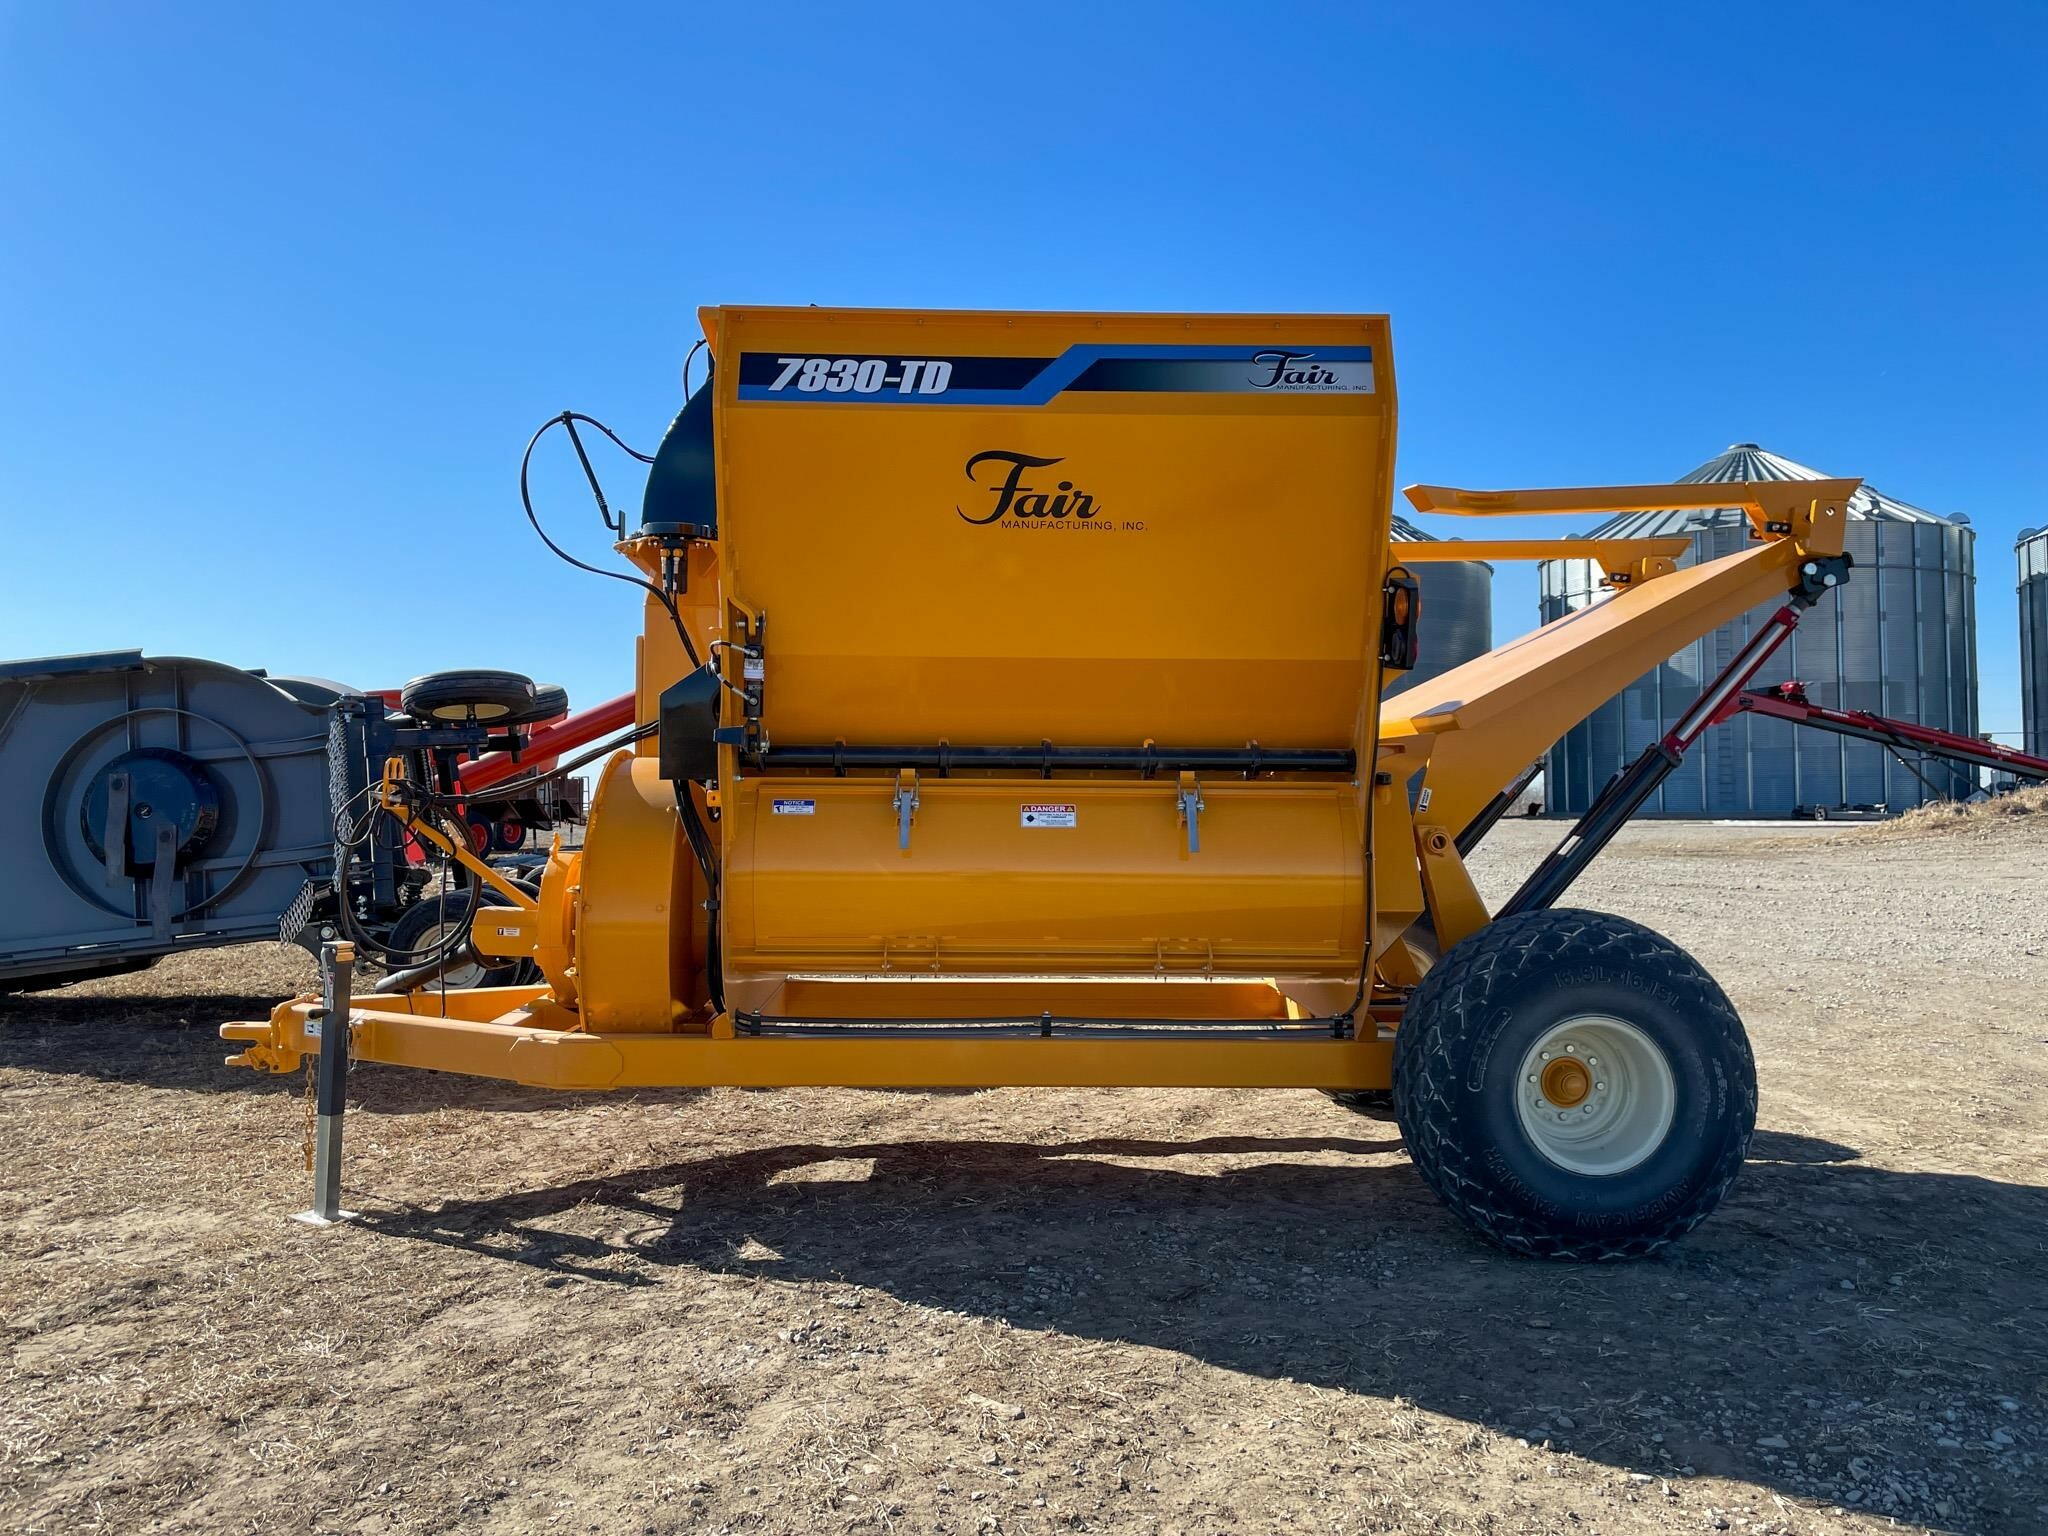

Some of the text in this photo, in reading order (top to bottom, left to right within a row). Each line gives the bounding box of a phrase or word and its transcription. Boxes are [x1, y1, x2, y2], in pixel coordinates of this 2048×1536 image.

[768, 358, 952, 394] 7830-TD
[1247, 350, 1340, 388] Fair
[957, 450, 1101, 525] Fair
[1001, 520, 1148, 531] MANUFACTURING, INC.
